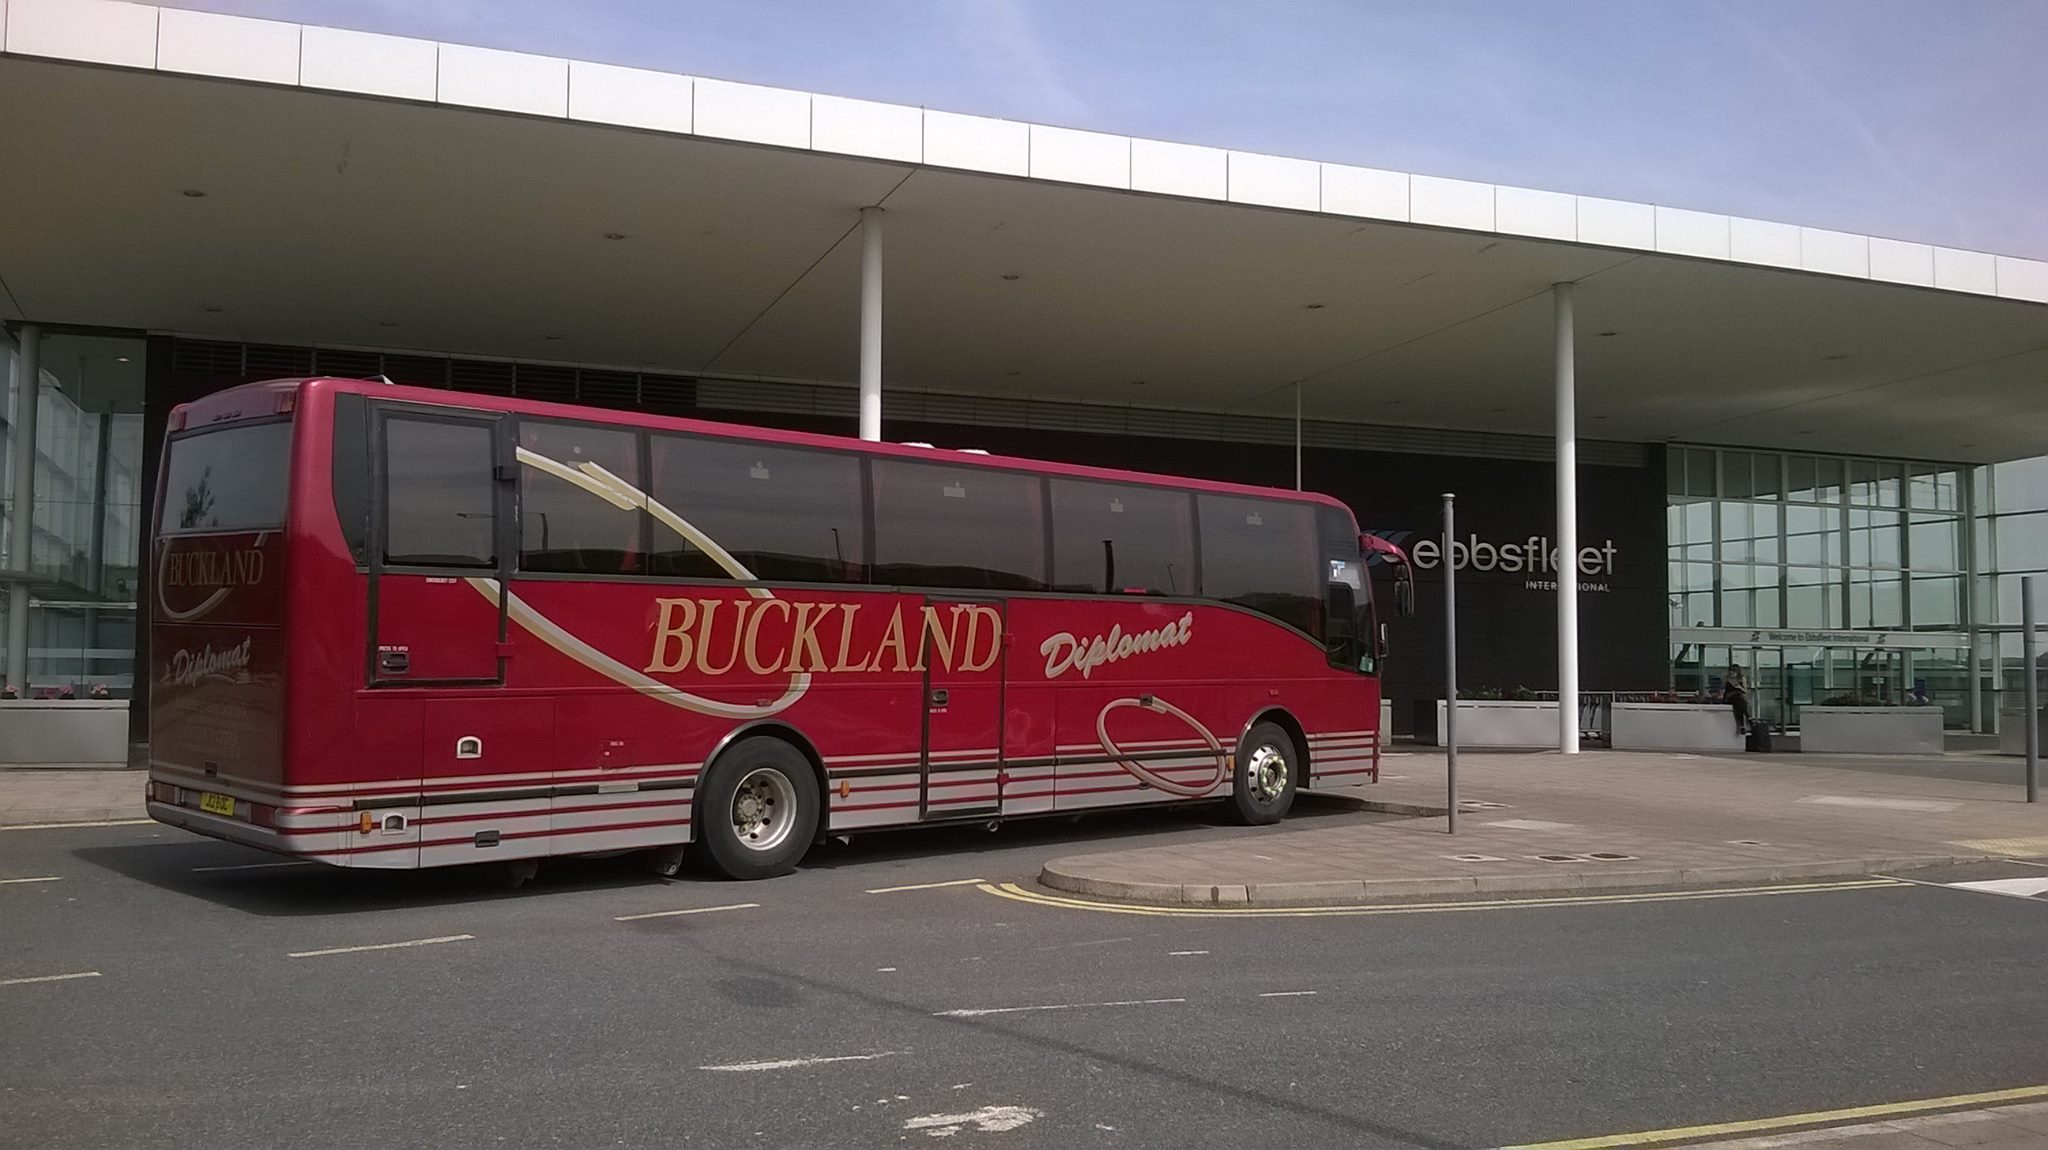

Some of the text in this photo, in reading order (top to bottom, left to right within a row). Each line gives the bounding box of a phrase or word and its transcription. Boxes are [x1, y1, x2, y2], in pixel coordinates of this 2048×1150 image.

[168, 549, 264, 587] BUCKLAND
[1412, 532, 1617, 575] ebbsflet
[1525, 580, 1611, 593] INTERIONAL
[644, 597, 1002, 676] BUCKLAND
[1040, 610, 1193, 680] Diplomat
[1768, 632, 1797, 642] Welcome
[1798, 633, 1805, 642] to
[1832, 633, 1870, 643] International
[172, 635, 251, 687] Diplomat
